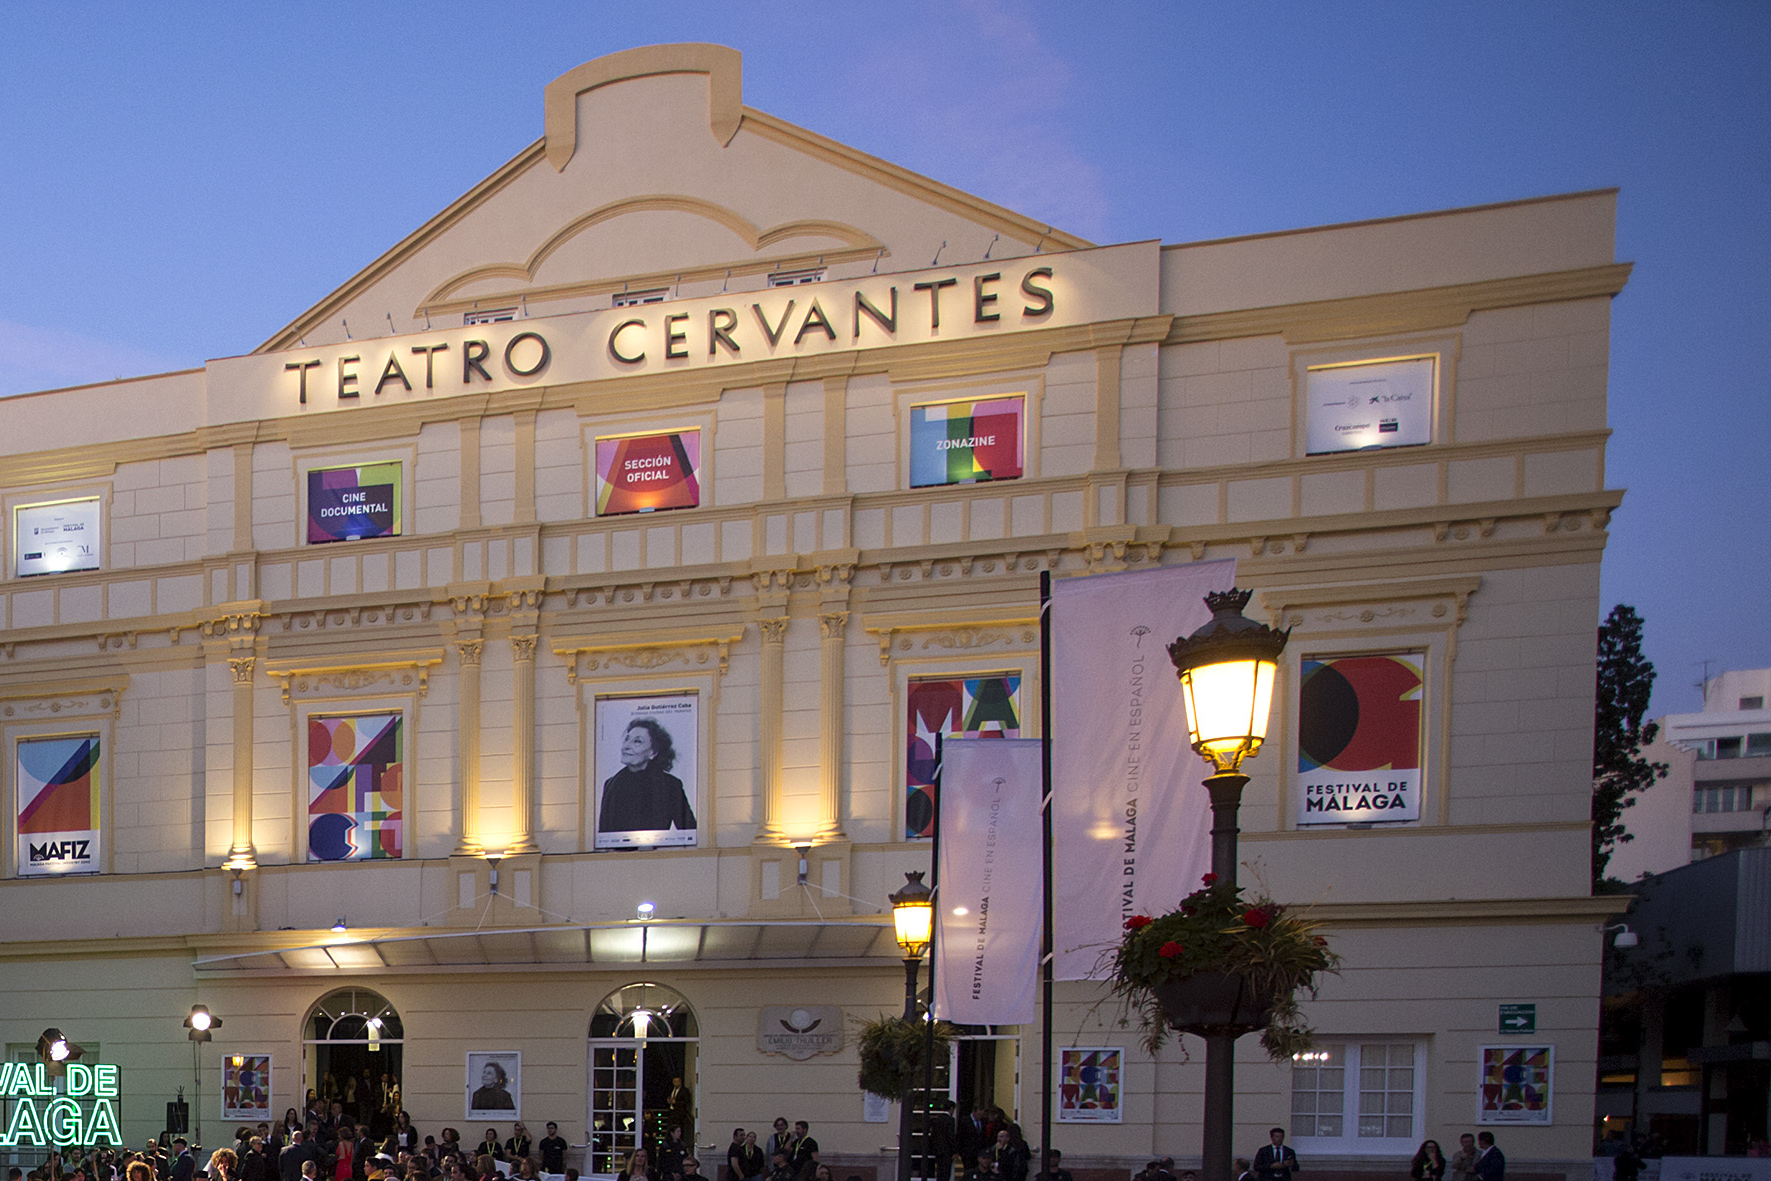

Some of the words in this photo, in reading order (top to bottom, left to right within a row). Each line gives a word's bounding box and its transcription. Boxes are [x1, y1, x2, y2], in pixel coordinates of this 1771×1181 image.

[285, 331, 552, 404] TEATRO
[608, 267, 1054, 363] CERVANTES
[936, 435, 996, 450] ZONAZINE
[624, 454, 671, 470] SECCIÓN
[627, 470, 669, 483] OFICIAL
[342, 492, 366, 503] CINE
[321, 503, 388, 518] DOCUMENTAL
[1130, 654, 1145, 727] ESPAÑOL
[1128, 731, 1141, 752] EN
[1127, 759, 1139, 793] CINE
[1307, 783, 1380, 795] FESTIVAL
[1388, 781, 1408, 792] DE
[1306, 794, 1407, 812] MÁLAGA
[30, 840, 90, 861] MAFIZ
[986, 850, 994, 864] EN
[1123, 858, 1135, 876] DE
[982, 866, 993, 893] CINE
[977, 938, 986, 951] DE
[972, 954, 985, 1000] FESTIVAL
[67, 1063, 118, 1096] DE
